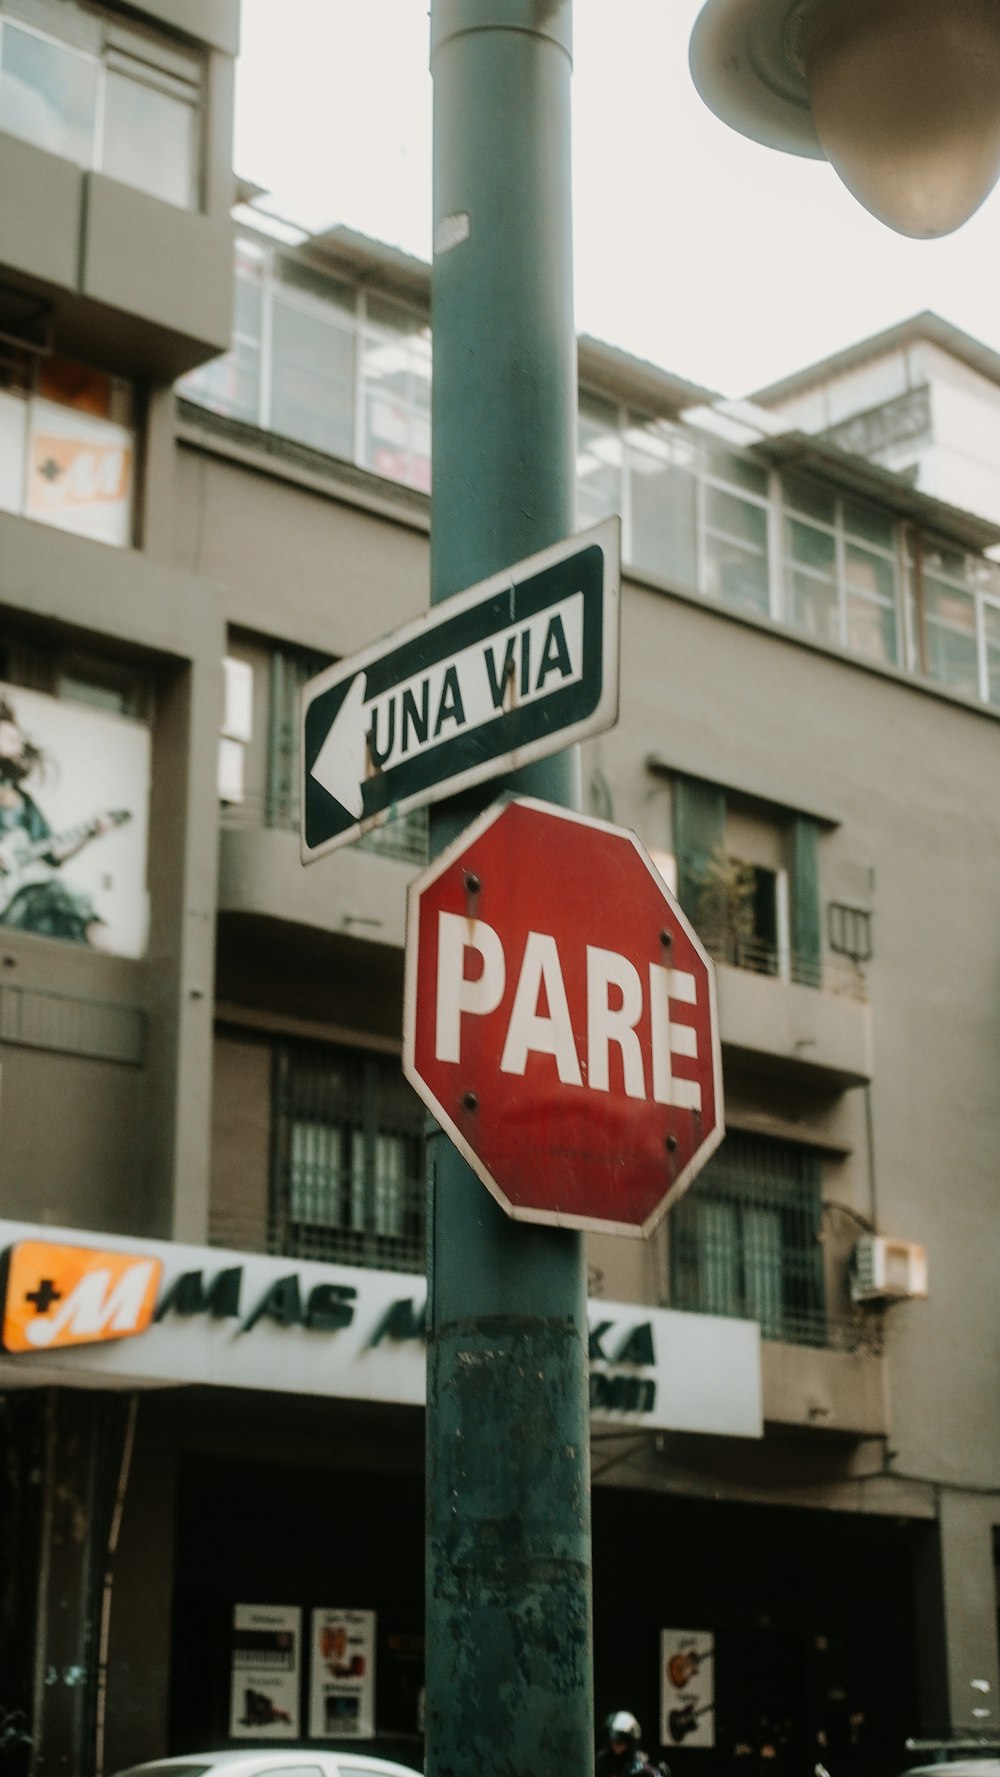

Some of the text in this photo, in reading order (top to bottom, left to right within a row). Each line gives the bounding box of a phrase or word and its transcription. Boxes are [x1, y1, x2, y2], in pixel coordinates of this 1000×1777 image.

[366, 610, 574, 769] UNA VIA
[435, 910, 702, 1113] PARE
[153, 1265, 358, 1333] MAS
